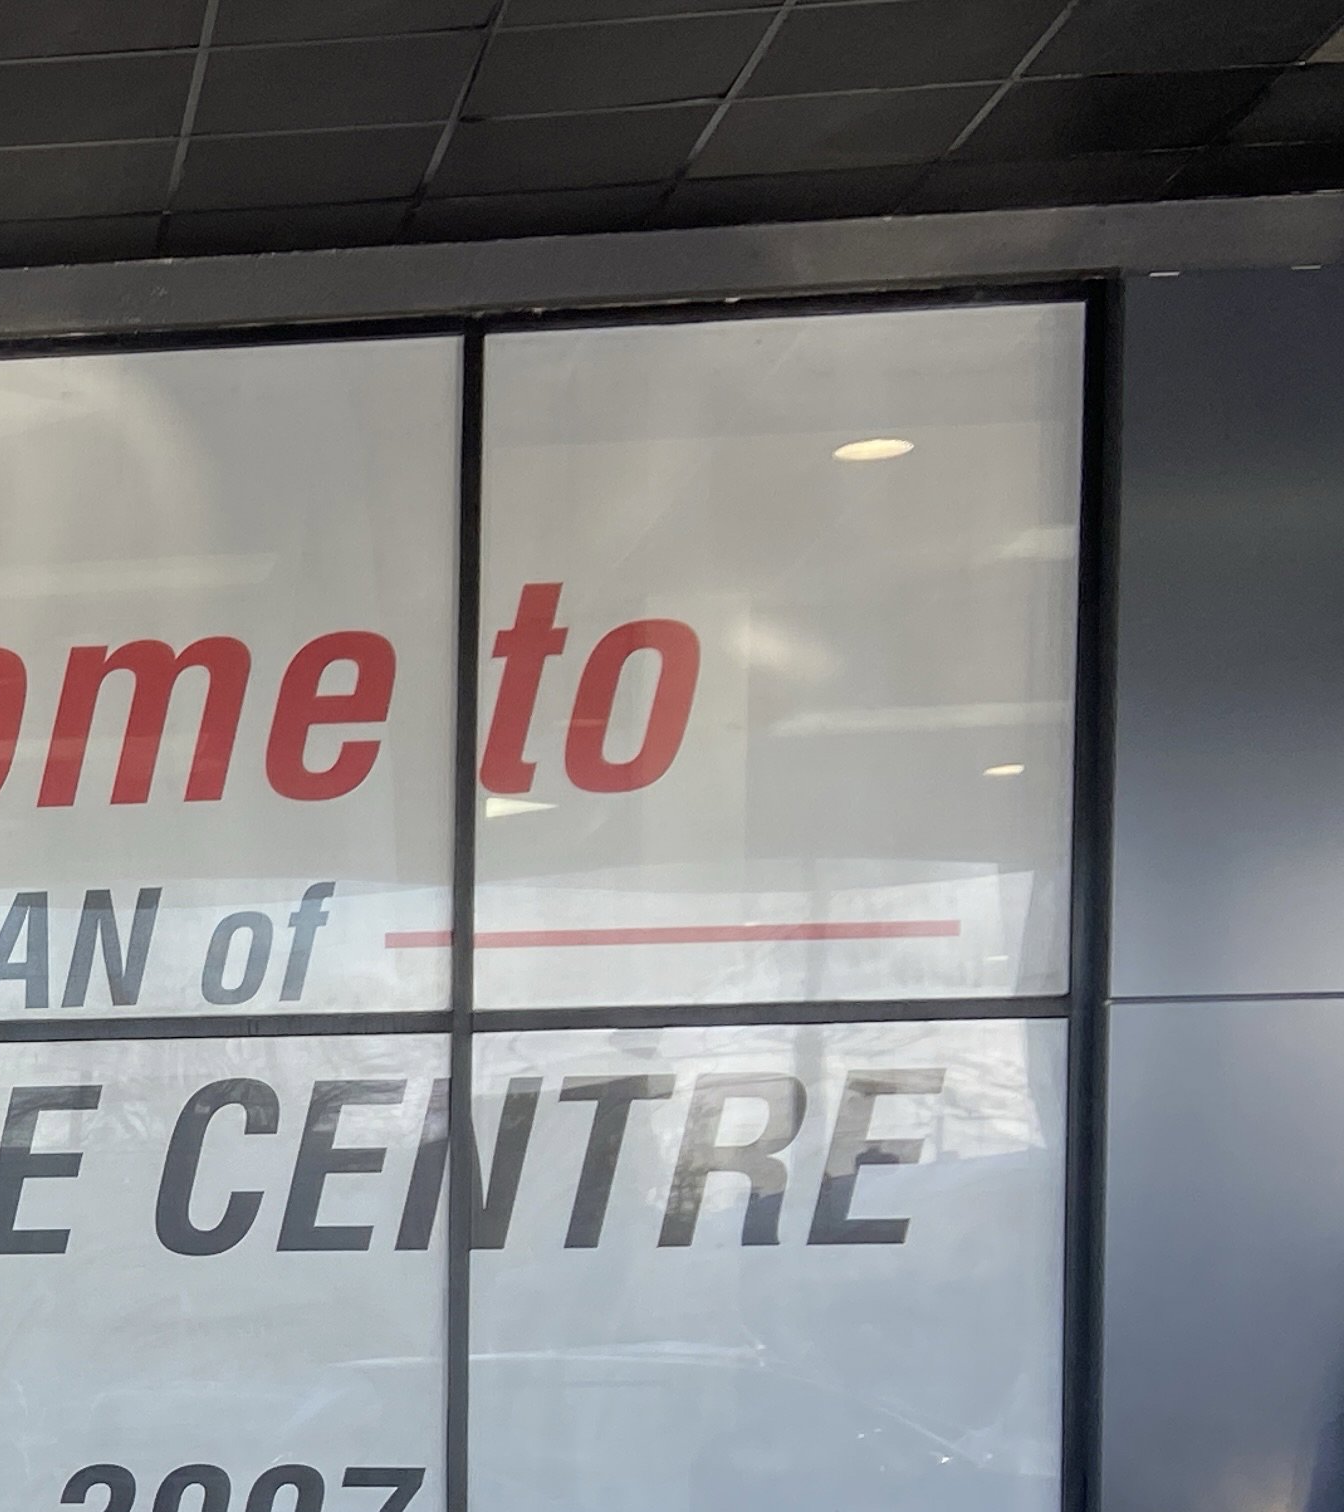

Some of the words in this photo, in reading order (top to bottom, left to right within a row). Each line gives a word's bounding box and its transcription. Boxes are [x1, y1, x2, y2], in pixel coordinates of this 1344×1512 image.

[477, 582, 702, 797] to
[200, 881, 334, 1007] of
[154, 1067, 944, 1256] CENTRE
